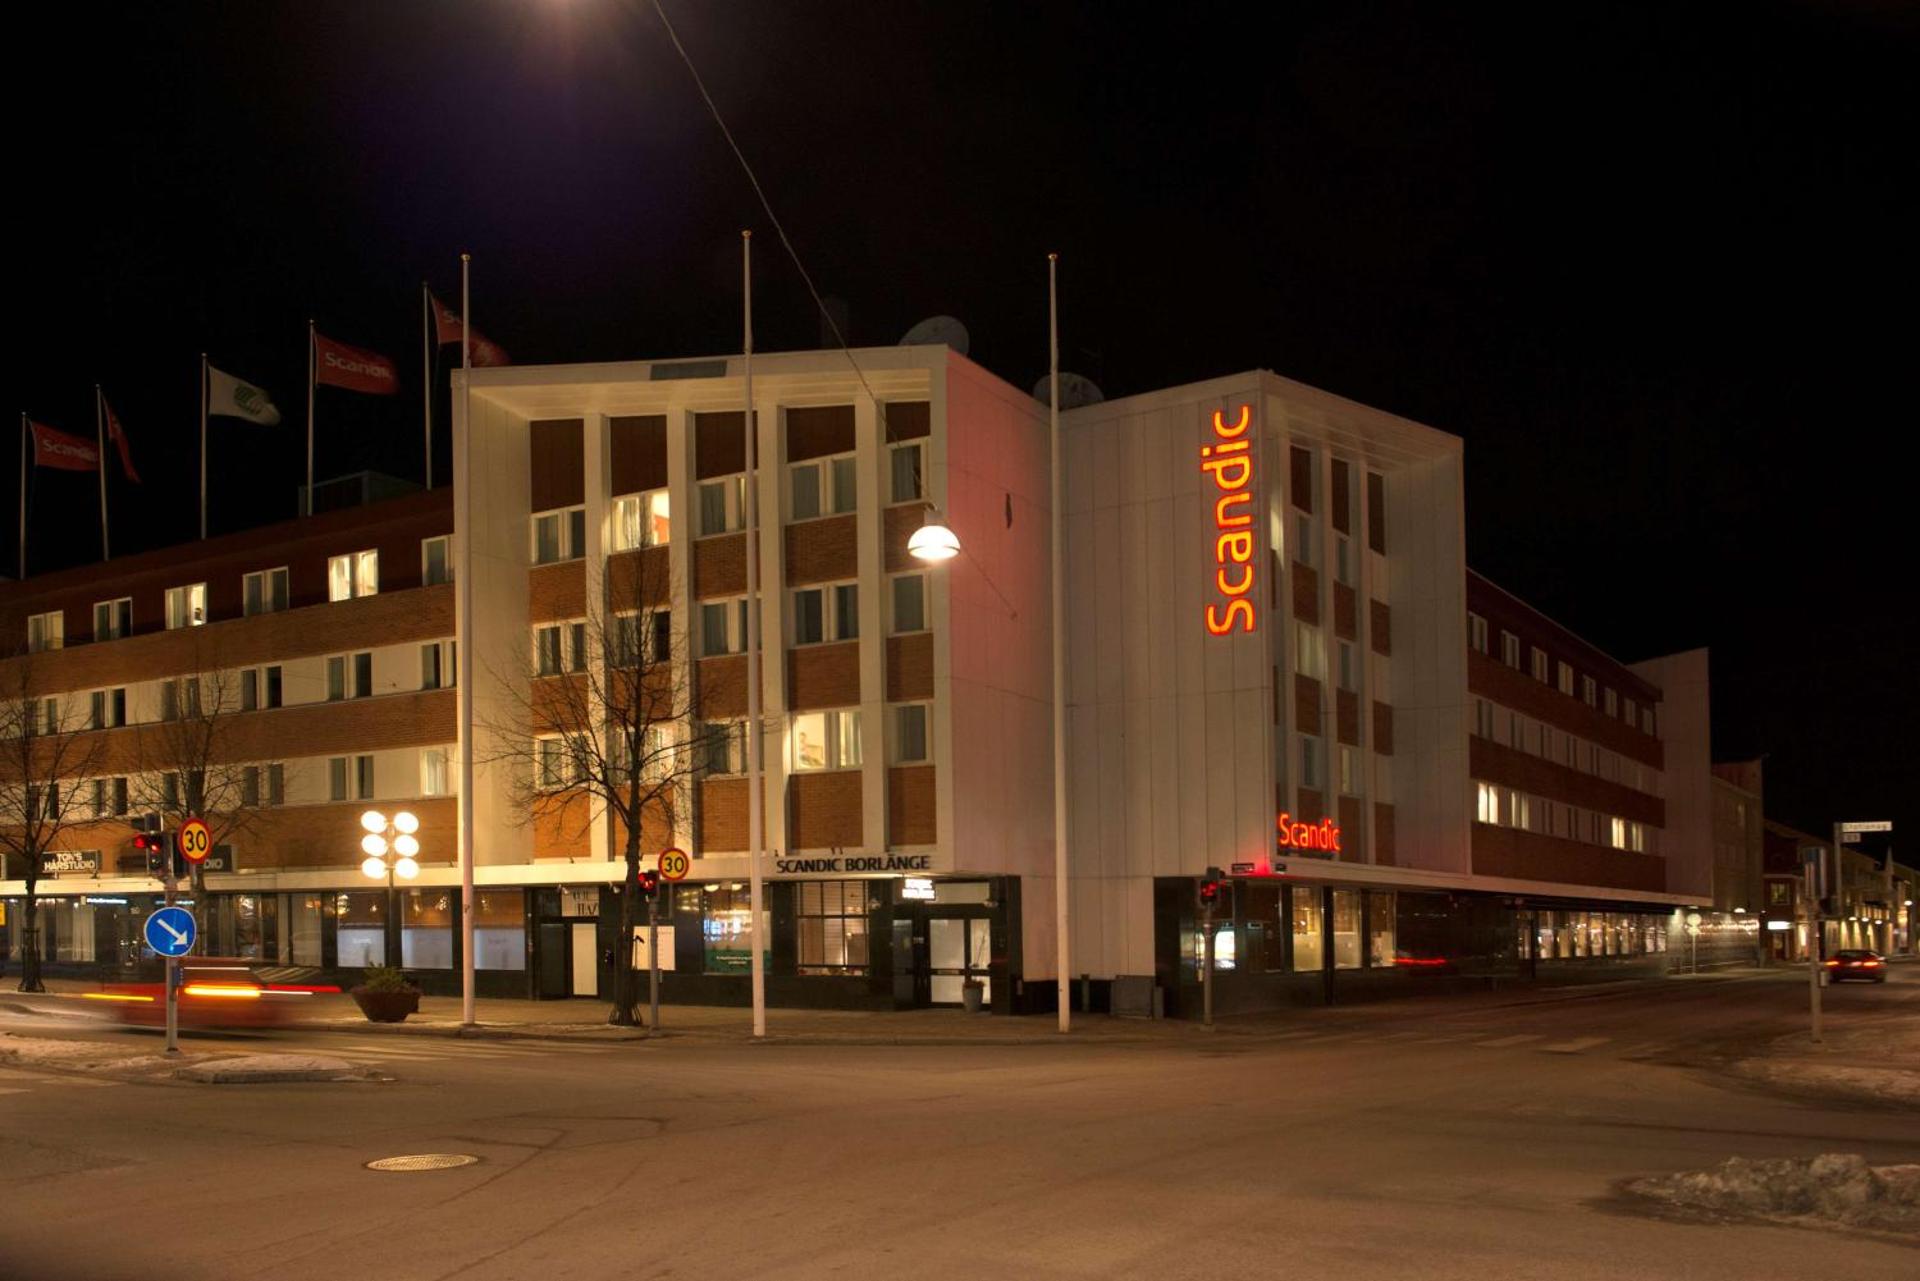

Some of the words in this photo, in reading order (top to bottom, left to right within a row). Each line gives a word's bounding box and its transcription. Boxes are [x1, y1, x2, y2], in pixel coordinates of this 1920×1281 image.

[43, 439, 96, 462] Scan
[1202, 406, 1254, 636] Scandic
[185, 830, 207, 852] 30
[1279, 813, 1340, 851] Scandic
[664, 856, 684, 873] 30
[777, 858, 841, 873] SCANDIC
[845, 854, 931, 871] BORLÄNGE
